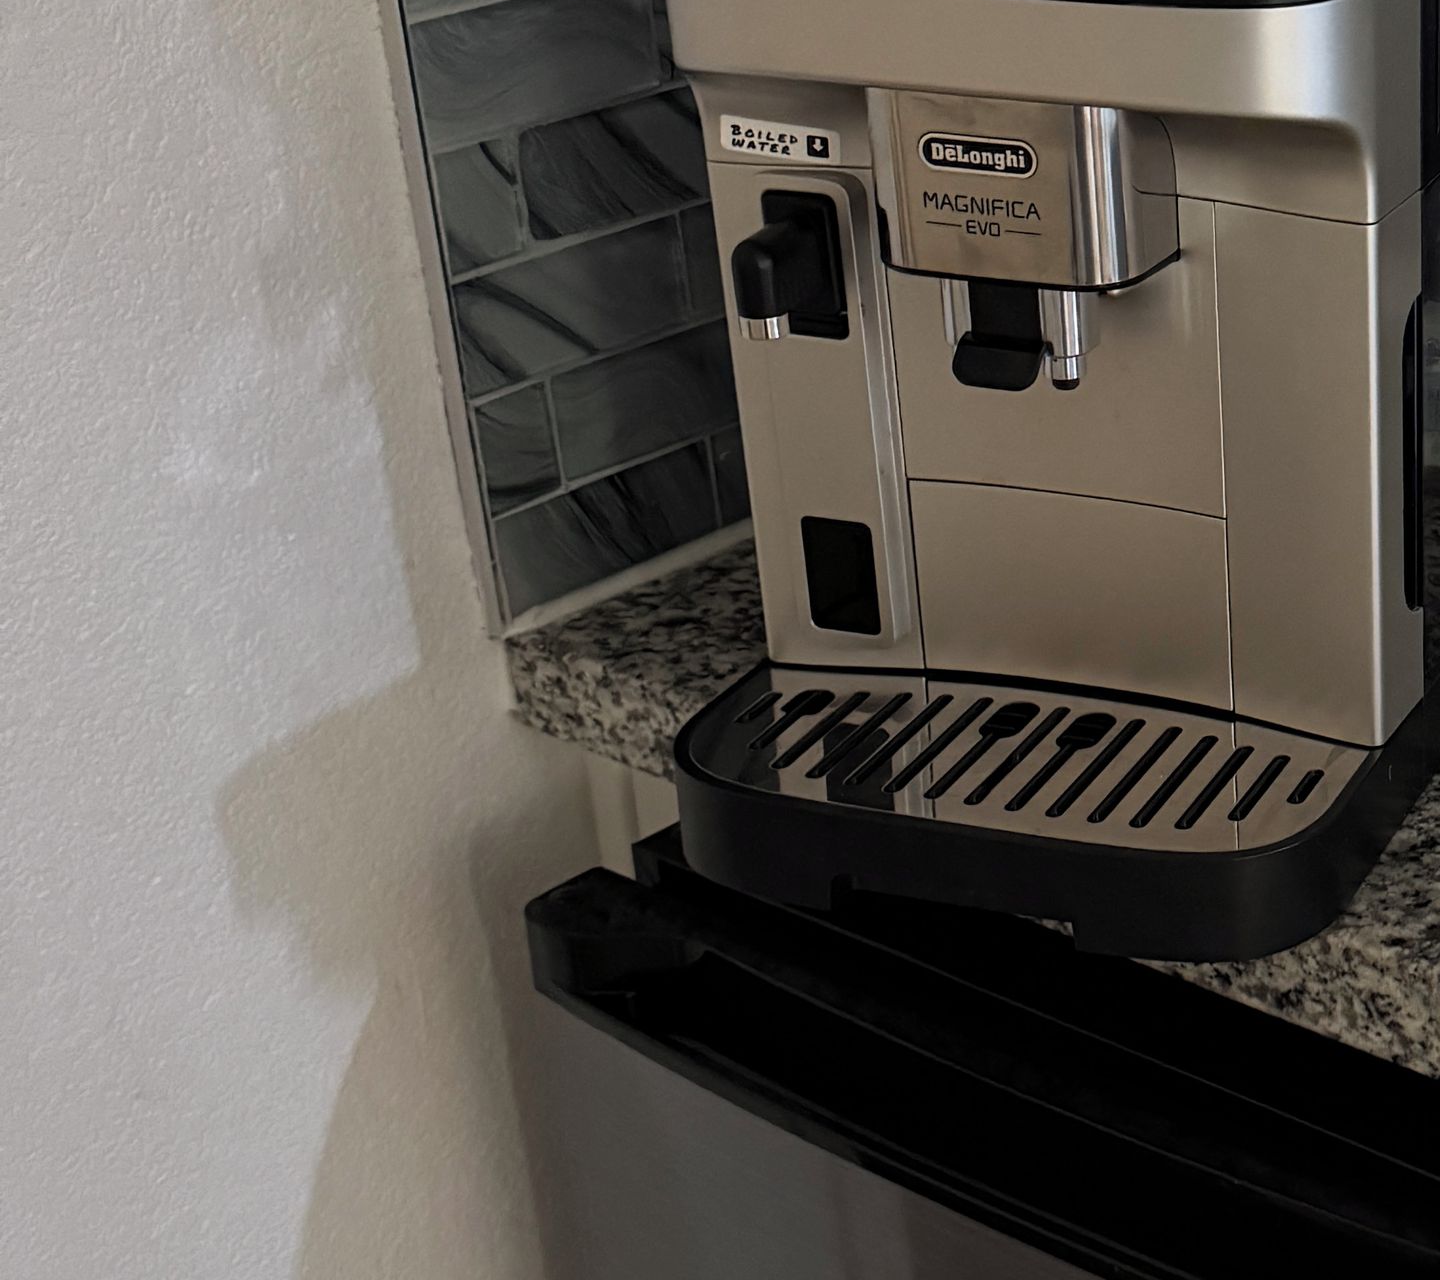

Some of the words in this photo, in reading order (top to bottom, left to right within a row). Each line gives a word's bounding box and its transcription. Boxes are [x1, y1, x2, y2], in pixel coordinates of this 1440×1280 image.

[730, 124, 799, 145] BOILED
[730, 138, 792, 156] WATER
[922, 191, 1041, 221] MAGNIFICA
[965, 220, 1001, 237] EVO
